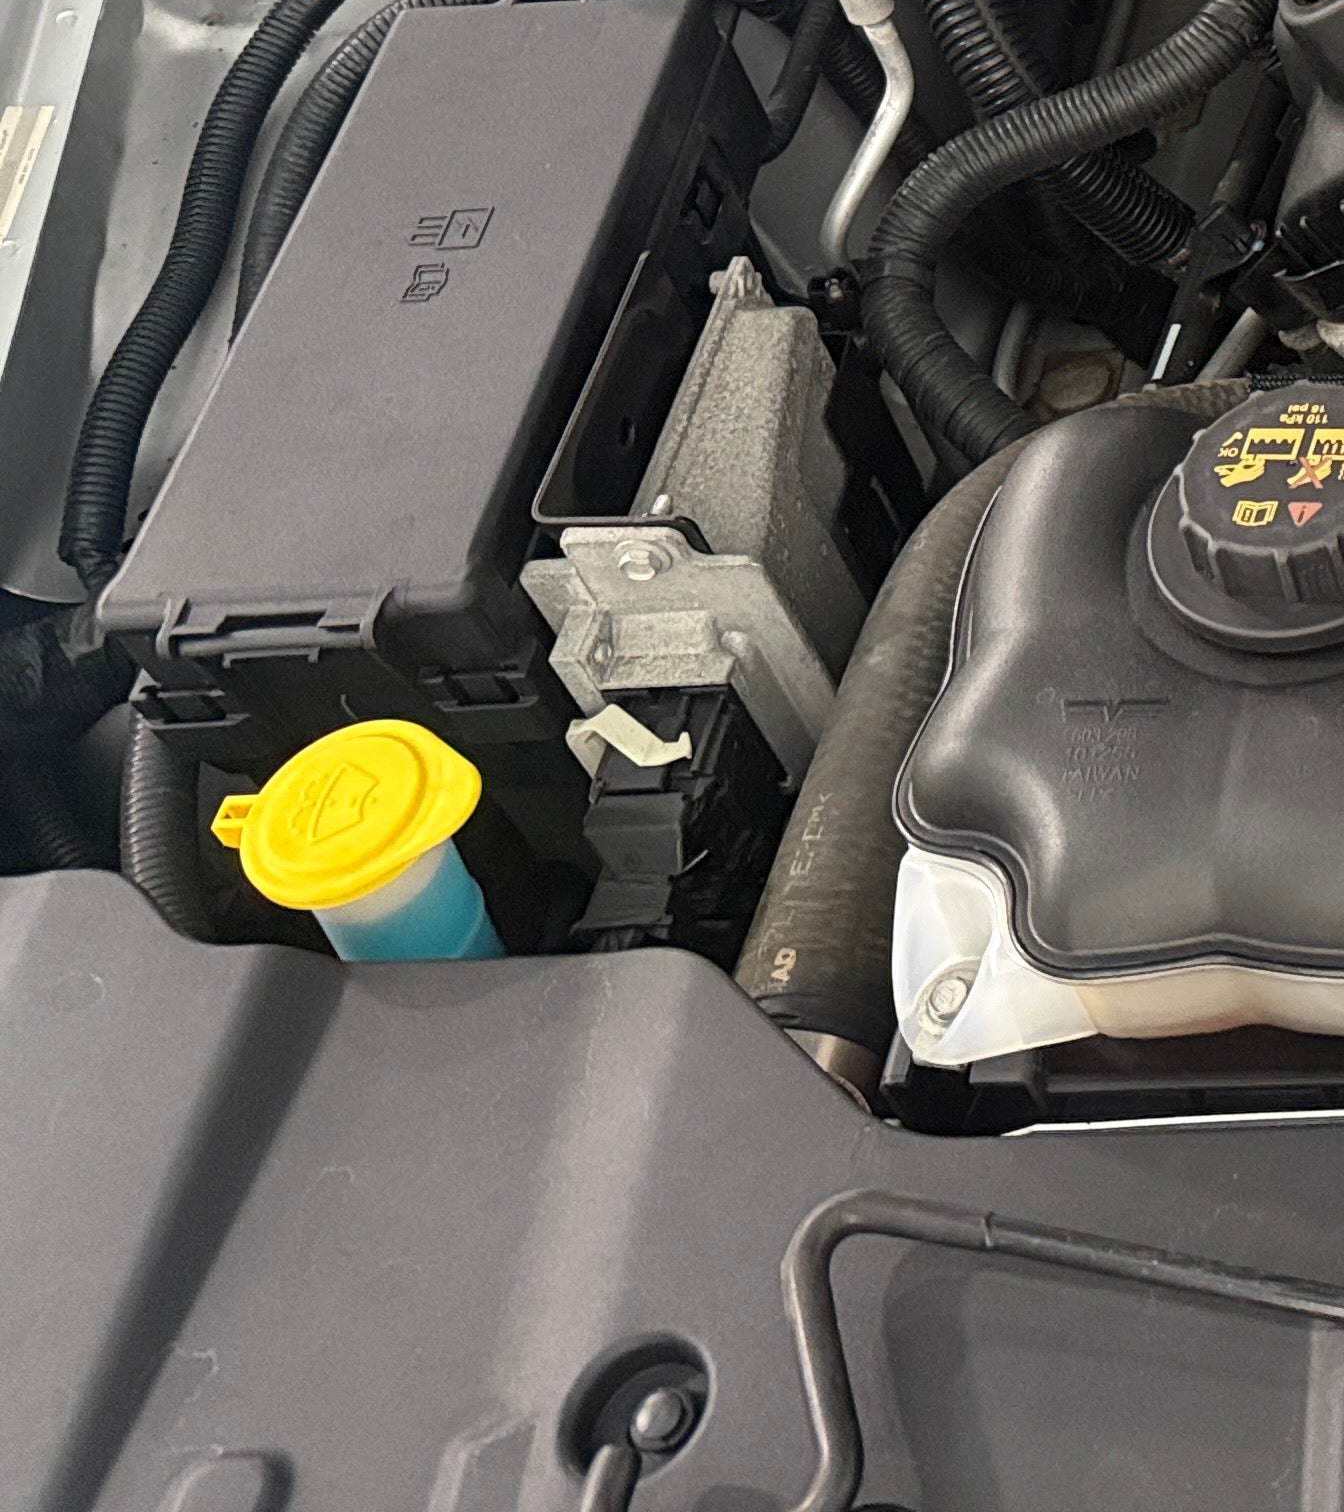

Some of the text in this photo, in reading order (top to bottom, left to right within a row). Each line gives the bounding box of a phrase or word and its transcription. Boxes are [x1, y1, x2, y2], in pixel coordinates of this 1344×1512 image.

[1279, 413, 1329, 425] 110 kPa
[1217, 447, 1239, 457] OK
